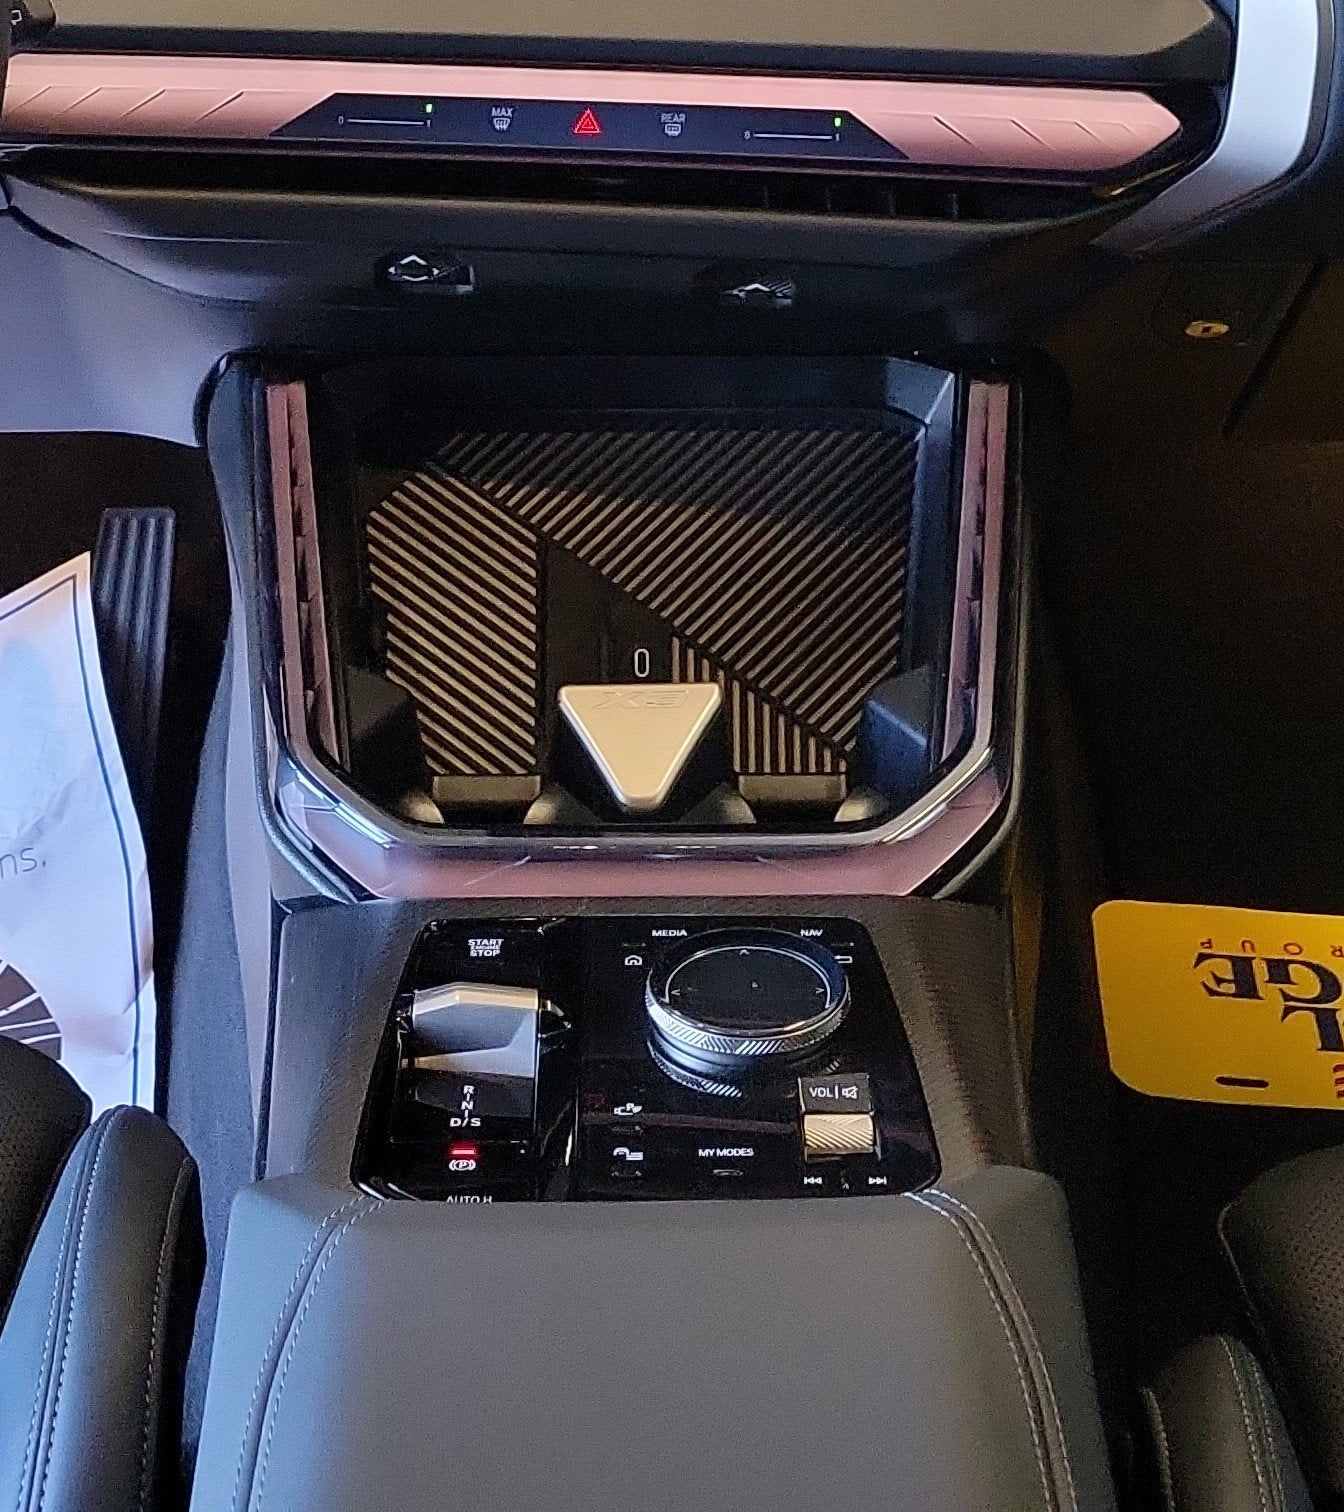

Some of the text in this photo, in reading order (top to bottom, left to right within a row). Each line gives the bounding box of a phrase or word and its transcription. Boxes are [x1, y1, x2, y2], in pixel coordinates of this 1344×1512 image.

[491, 106, 514, 118] MAX
[660, 113, 687, 124] REAR
[651, 929, 688, 937] MEDIA
[800, 929, 824, 937] NAV
[467, 938, 504, 946] START
[469, 949, 501, 957] STOP
[808, 1086, 834, 1098] VOL
[698, 1147, 755, 1158] MY MODES
